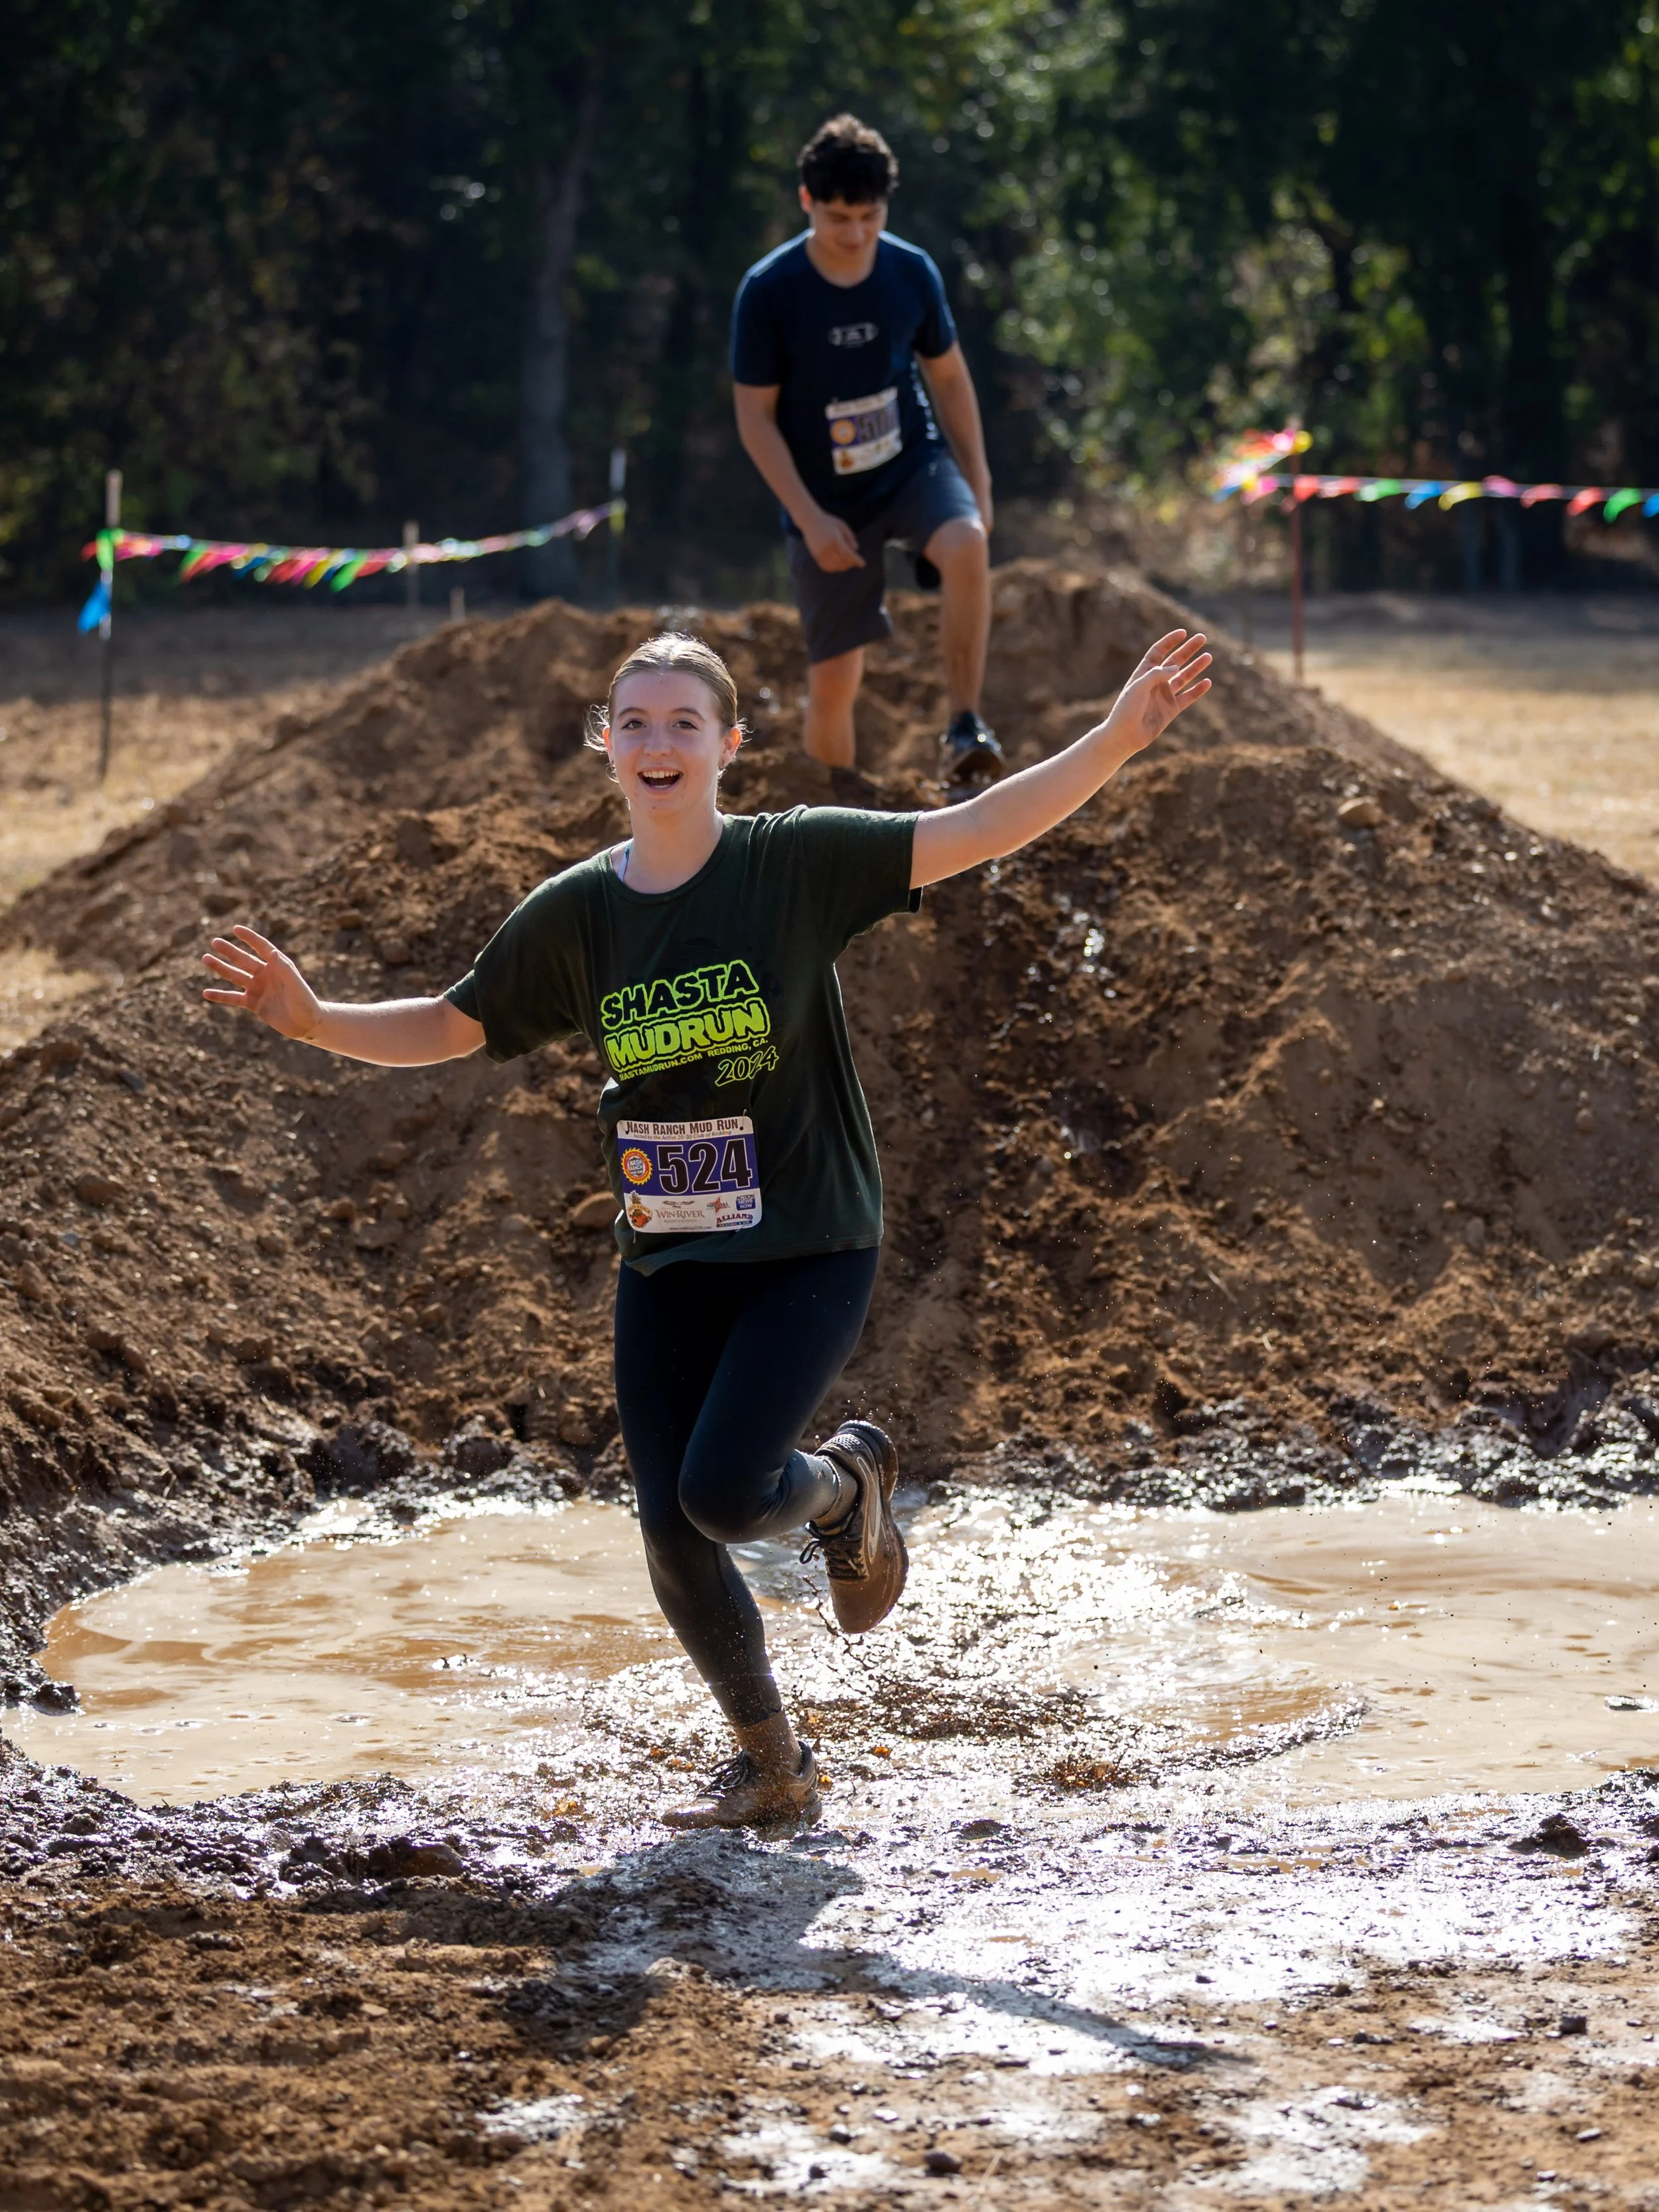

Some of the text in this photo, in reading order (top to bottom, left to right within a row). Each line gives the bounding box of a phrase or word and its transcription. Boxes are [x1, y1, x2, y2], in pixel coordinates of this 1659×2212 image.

[601, 959, 759, 1029] SHASTA
[604, 998, 770, 1072] MUDRUN
[707, 1043, 751, 1057] REDDING,
[753, 1038, 768, 1048] CA.
[715, 1046, 779, 1087] 2024
[627, 1119, 738, 1135] NASH RANCH MUD RUN
[657, 1138, 753, 1194] 524
